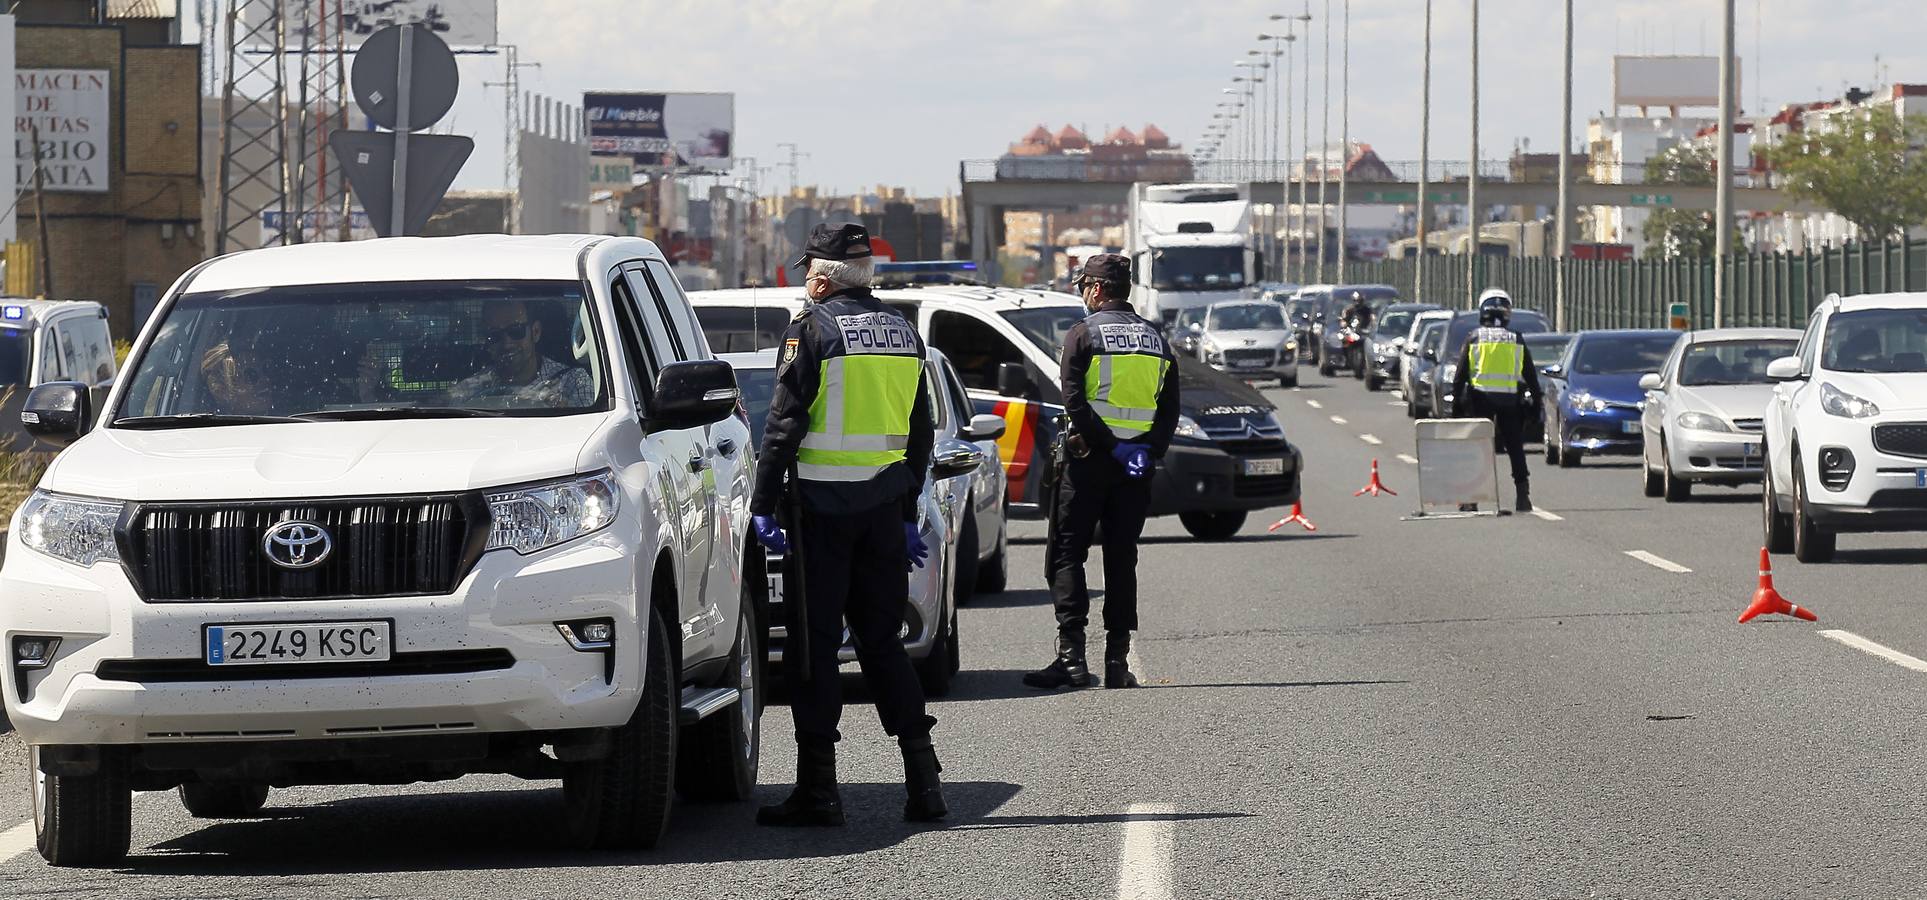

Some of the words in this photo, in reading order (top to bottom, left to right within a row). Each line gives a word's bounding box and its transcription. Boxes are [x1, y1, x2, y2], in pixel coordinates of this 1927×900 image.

[26, 95, 56, 112] DE
[606, 106, 661, 121] Mueble
[845, 328, 916, 349] POLICIA
[1105, 334, 1161, 351] POLICIA
[230, 629, 308, 660] 2249
[319, 627, 376, 657] KSC
